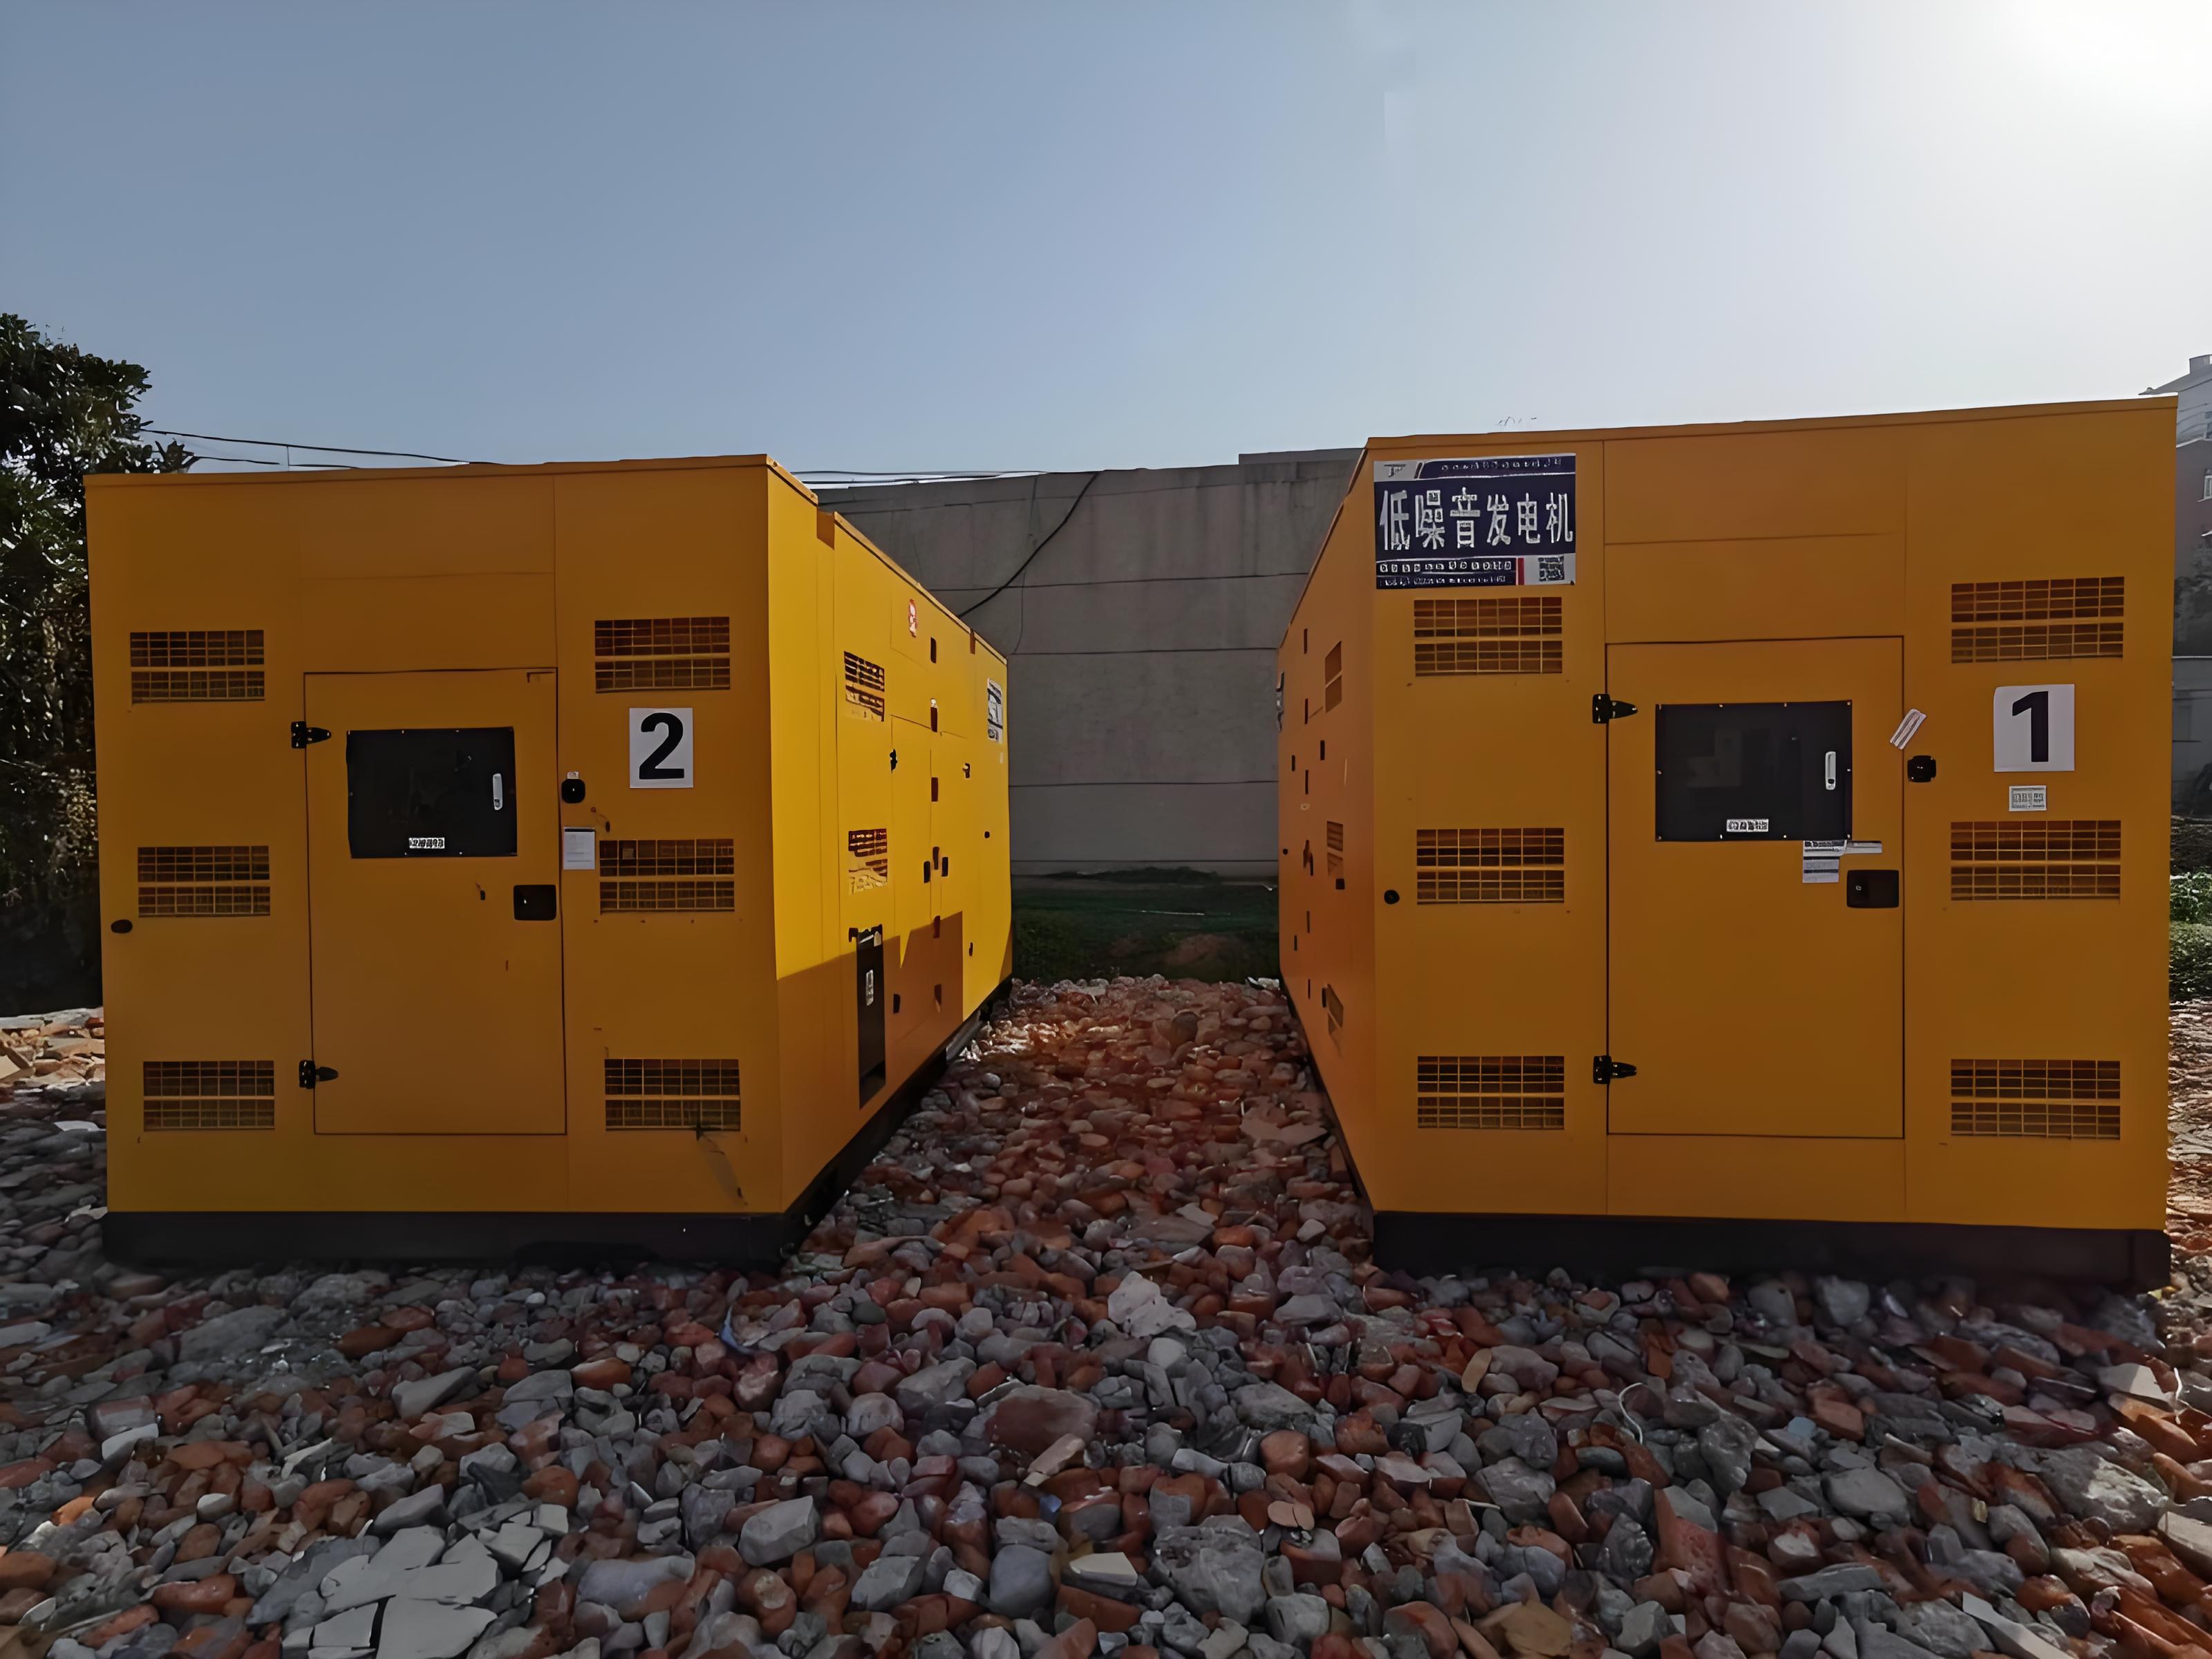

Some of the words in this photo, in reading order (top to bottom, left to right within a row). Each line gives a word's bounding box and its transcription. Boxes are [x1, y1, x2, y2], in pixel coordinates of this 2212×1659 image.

[1380, 487, 1573, 551] 低噪音发电机
[639, 713, 685, 780] 2
[2012, 691, 2049, 762] 1
